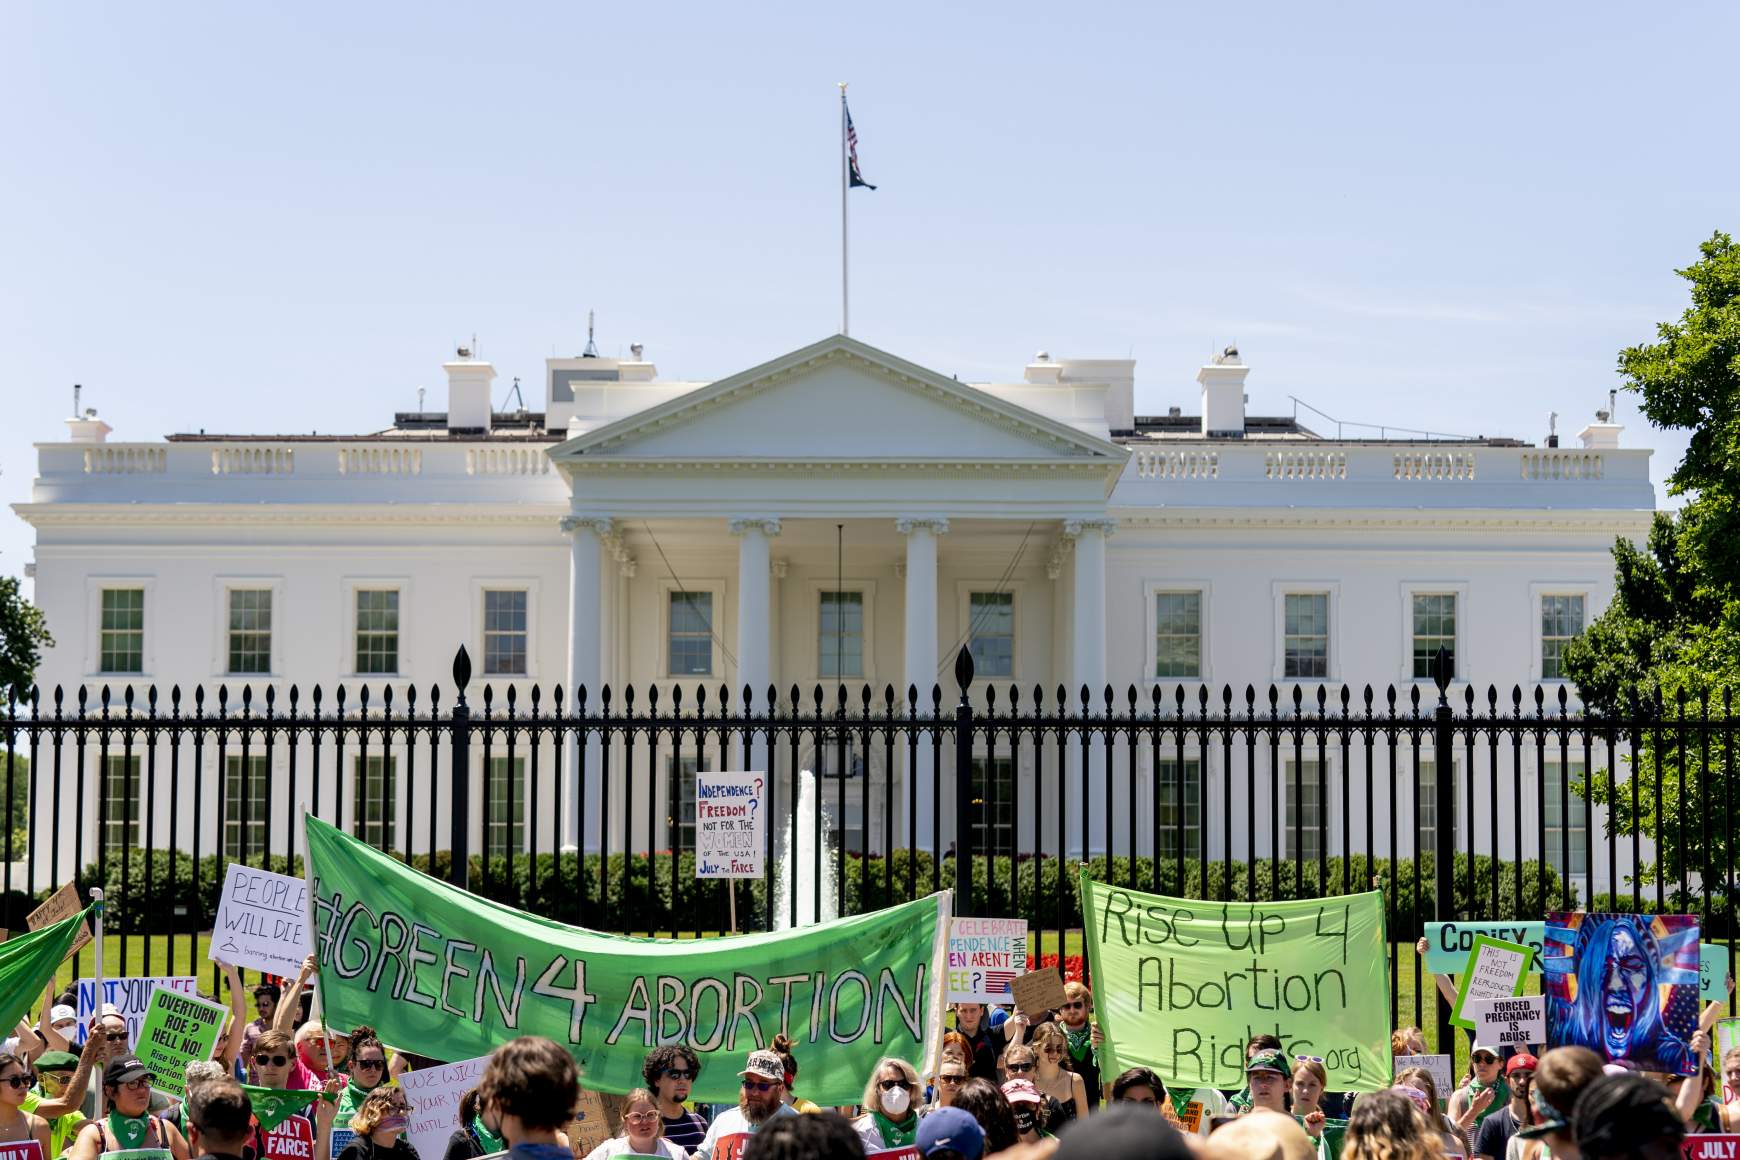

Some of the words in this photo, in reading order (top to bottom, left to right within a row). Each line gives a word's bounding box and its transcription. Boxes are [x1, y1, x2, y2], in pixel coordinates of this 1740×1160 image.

[703, 821, 717, 831] NOT
[721, 821, 734, 831] FOR
[738, 820, 754, 831] THE
[699, 831, 753, 849] WOMEN
[700, 860, 719, 874] JULY
[731, 860, 754, 873] FARCE
[232, 873, 306, 912] PEOPLE
[225, 906, 268, 938] WILL
[274, 919, 303, 945] DIE
[959, 920, 1026, 935] CELEBRATE
[1102, 890, 1199, 947] Rise
[1315, 904, 1350, 965] 4
[971, 952, 1010, 967] AREN'T
[1012, 937, 1026, 969] WHEN
[1491, 959, 1508, 969] NOT
[1138, 957, 1346, 1012] Abortion
[158, 994, 218, 1025] OVERTURN
[605, 963, 926, 1052] ABORTION
[1494, 1000, 1530, 1012] FORCED
[165, 1015, 189, 1033] ROE
[1485, 1010, 1541, 1023] PREGNANCY
[1509, 1022, 1519, 1031] IS
[151, 1027, 177, 1052] HELL
[180, 1038, 202, 1057] NO!
[1500, 1031, 1531, 1042] ABUSE
[151, 1049, 168, 1062] Rise
[170, 1056, 181, 1067] Up
[147, 1061, 182, 1080] Abortion
[403, 1071, 438, 1089] WE
[443, 1063, 481, 1083] WILL
[412, 1095, 450, 1115] YOUR
[410, 1118, 448, 1135] UNTIL
[267, 1136, 310, 1157] FARCE
[1698, 1141, 1737, 1159] JULY
